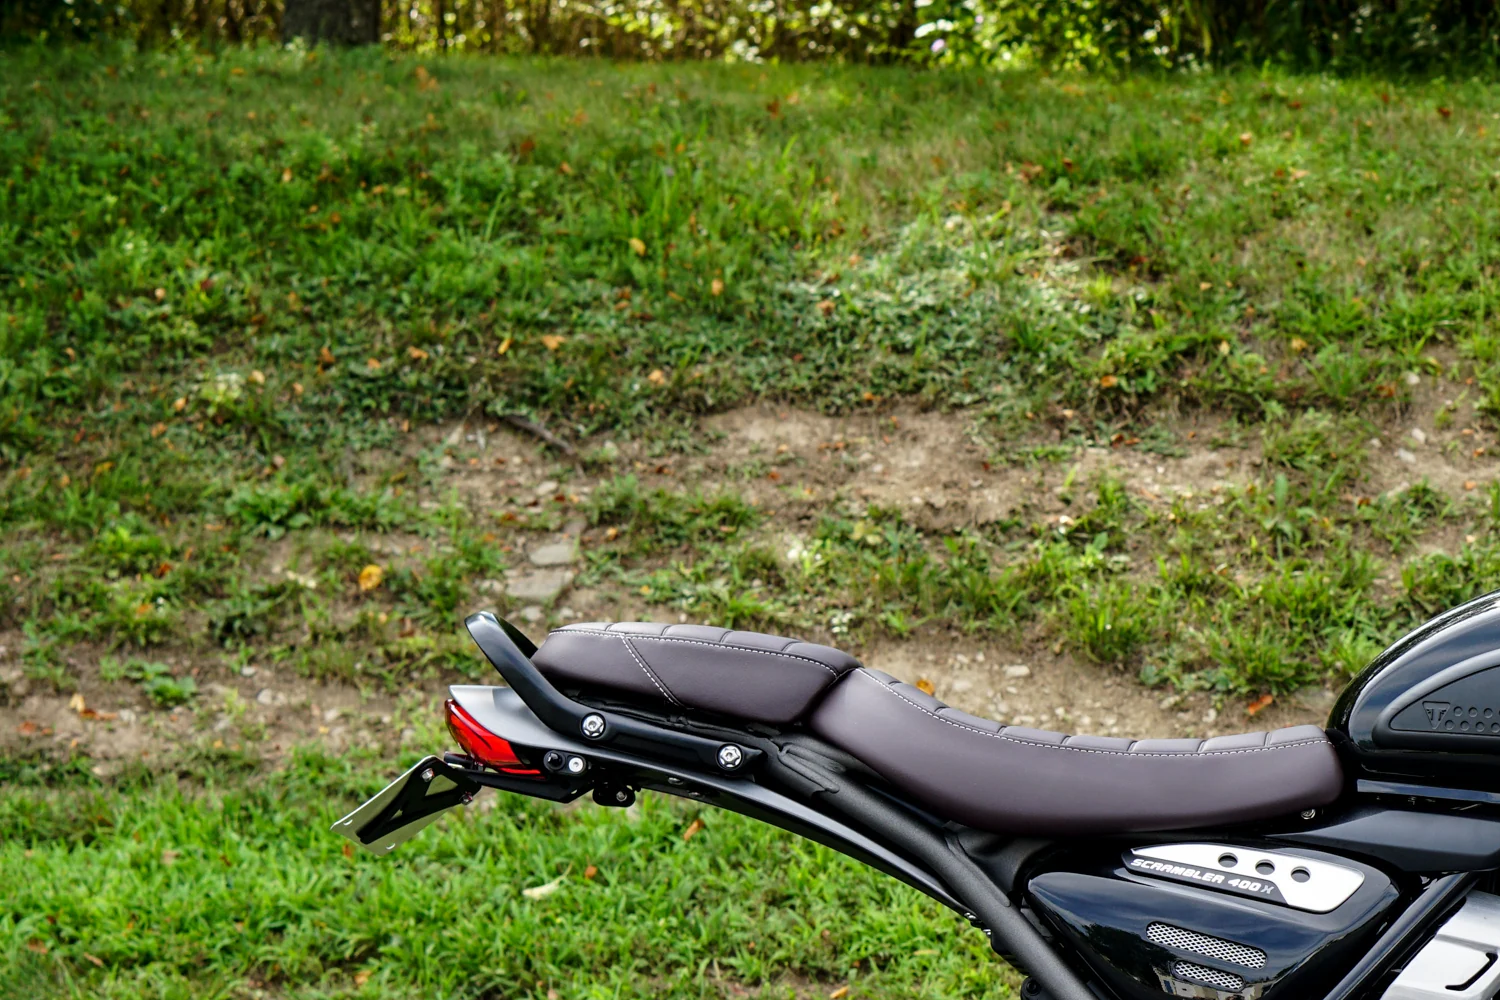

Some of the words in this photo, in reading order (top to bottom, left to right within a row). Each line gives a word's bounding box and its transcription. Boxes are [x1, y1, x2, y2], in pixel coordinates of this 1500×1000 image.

[1130, 858, 1225, 884] SCRAMBLER
[1227, 878, 1261, 892] 400
[1260, 884, 1275, 895] X
